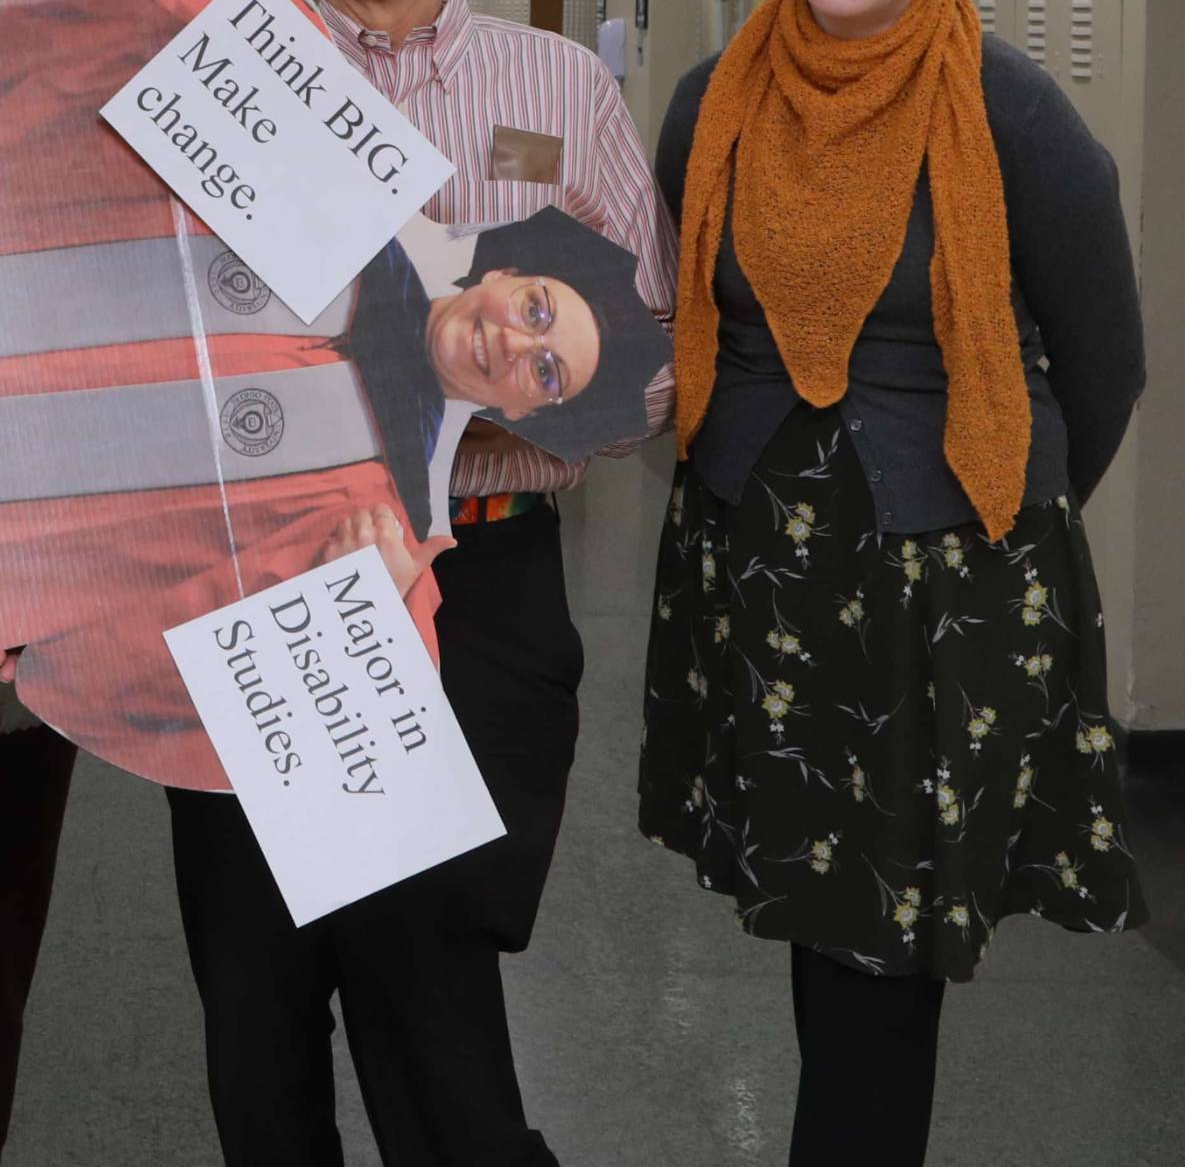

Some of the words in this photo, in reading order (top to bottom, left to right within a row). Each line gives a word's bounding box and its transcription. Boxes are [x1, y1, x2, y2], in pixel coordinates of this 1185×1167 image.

[136, 86, 257, 221] change.
[178, 31, 278, 144] Make
[323, 96, 409, 196] BIG.
[212, 619, 303, 787] Studies.
[267, 591, 386, 797] Disability
[324, 569, 406, 697] Major
[391, 706, 428, 754] in
